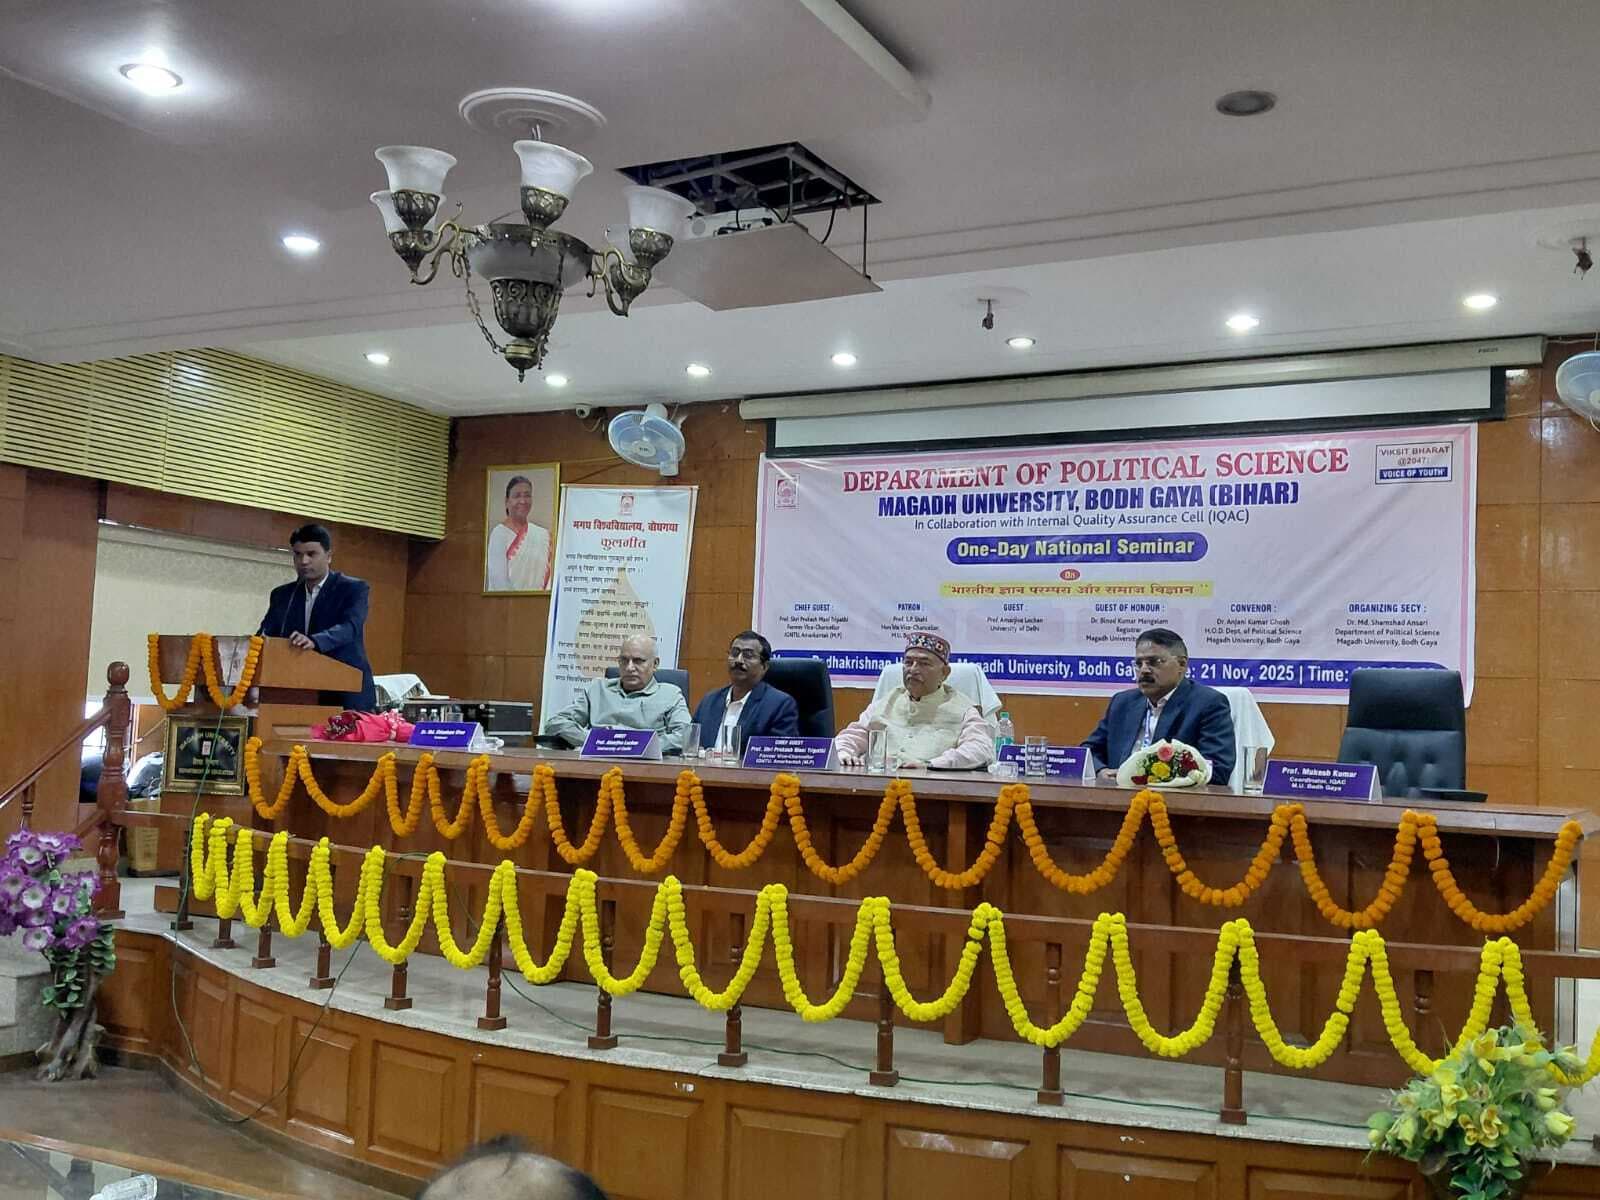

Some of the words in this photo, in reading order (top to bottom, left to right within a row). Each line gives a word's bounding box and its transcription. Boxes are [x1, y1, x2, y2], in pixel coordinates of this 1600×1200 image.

[1412, 445, 1450, 455] BHARAT
[843, 465, 1008, 492] DEPARTMENT
[1016, 463, 1051, 485] OF
[1060, 455, 1206, 483] POLITICAL
[1216, 448, 1349, 477] SCIENCE
[1382, 470, 1405, 478] VOICE
[1406, 469, 1417, 477] OF
[878, 495, 957, 517] MAGADH
[963, 490, 1079, 513] UNIVERSITY,
[1085, 487, 1144, 510] BODH
[1150, 484, 1204, 508] GAYA
[1210, 482, 1299, 506] (BIHAR)
[915, 519, 924, 529] In
[927, 517, 997, 530] Collaboration
[1000, 516, 1024, 528] with
[1027, 515, 1070, 527] Internal
[1073, 514, 1114, 529] Quality
[1118, 512, 1178, 524] Assurance
[1181, 511, 1204, 523] Cell
[1208, 510, 1250, 525] (IQAC)
[601, 536, 646, 550] कुलगीत
[957, 542, 1030, 560] One-Day
[1035, 539, 1111, 556] National
[1117, 538, 1195, 555] Seminar
[999, 586, 1024, 595] ज्ञान
[1078, 584, 1100, 594] और
[898, 603, 920, 611] PATRON
[1095, 604, 1117, 612] GUEST
[1119, 604, 1128, 612] OF
[1130, 604, 1160, 612] HONOUR
[1230, 604, 1272, 613] CONVENOR
[1348, 604, 1398, 613] ORGANIZING
[1335, 628, 1375, 637] Department
[1206, 637, 1231, 645] Magadh
[1284, 637, 1300, 646] Gaya
[1336, 638, 1362, 646] Magadh
[1420, 639, 1438, 647] Gaya
[812, 655, 891, 670] dhakrishnan
[1008, 660, 1073, 679] University,
[1079, 661, 1111, 677] Bodh
[1115, 661, 1137, 680] Gay
[1201, 664, 1216, 679] 21
[1222, 664, 1254, 682] Nov,
[1259, 665, 1294, 681] 2025
[1308, 666, 1349, 682] Time:
[1282, 766, 1300, 774] Prof.
[1302, 767, 1331, 776] Mukesh
[1332, 769, 1357, 778] Kumar
